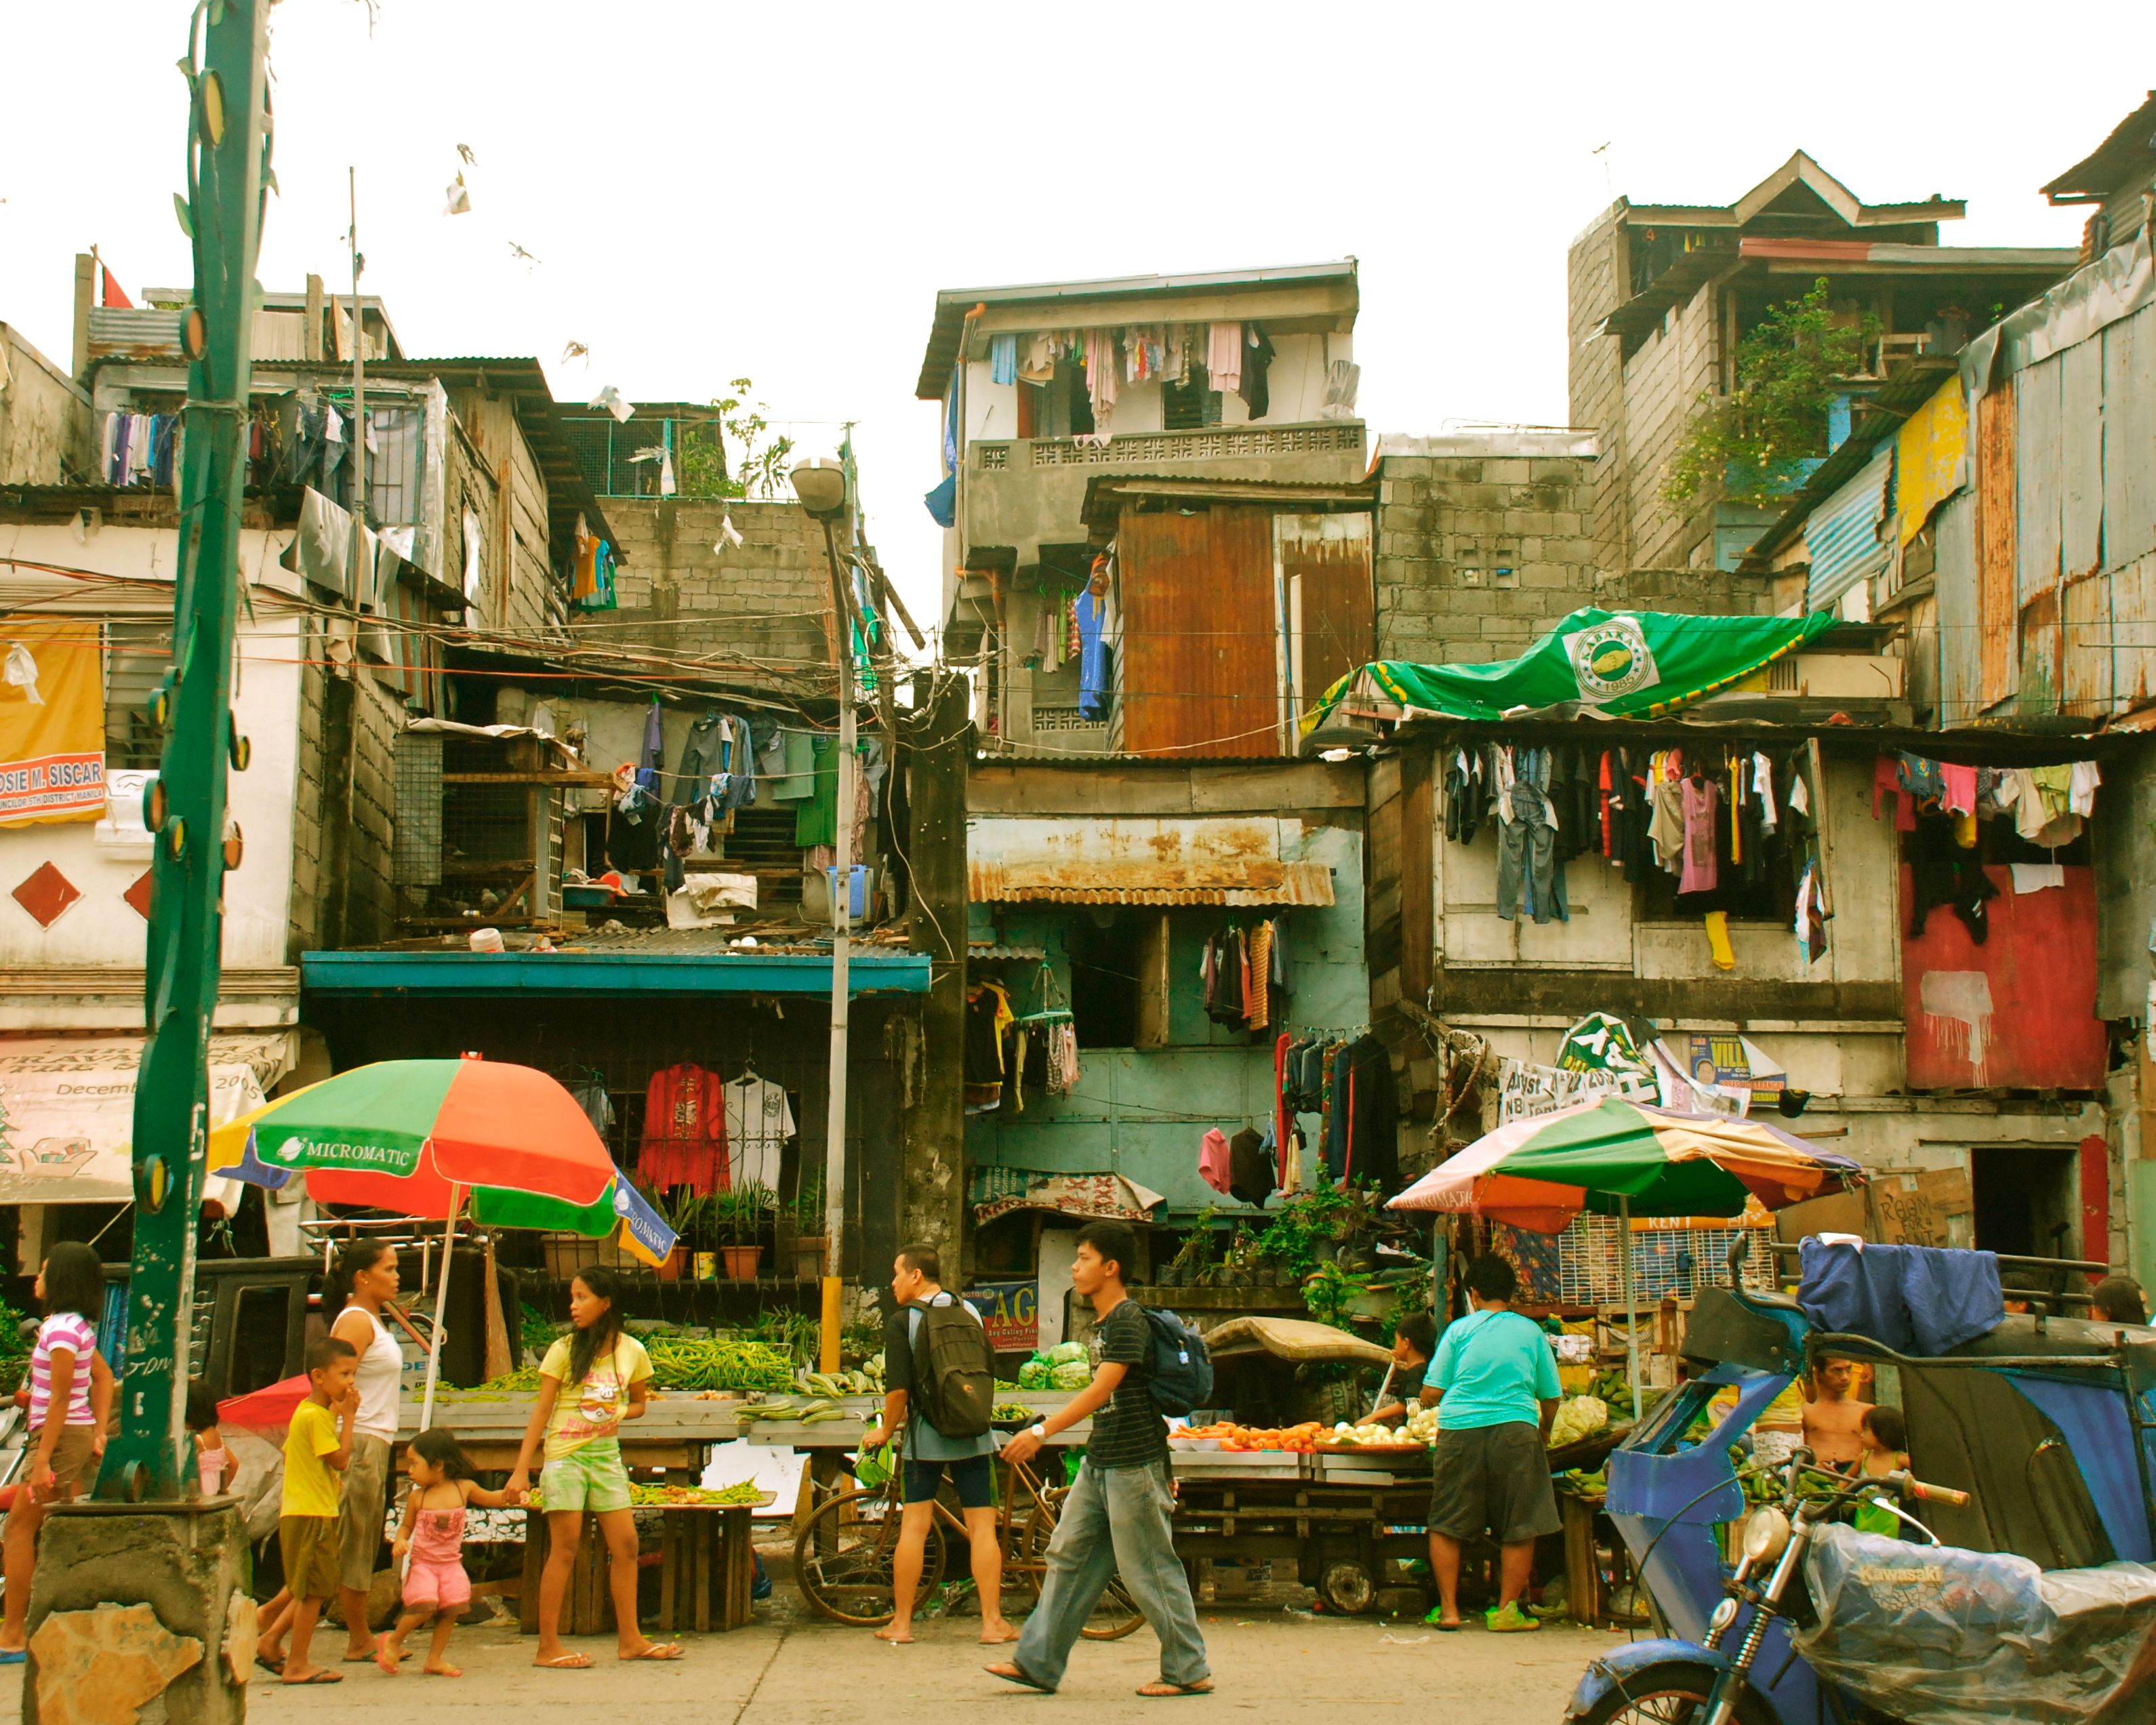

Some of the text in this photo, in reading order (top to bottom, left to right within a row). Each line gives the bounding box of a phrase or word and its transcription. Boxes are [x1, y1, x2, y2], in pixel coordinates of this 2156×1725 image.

[1581, 631, 1633, 660] KABAKA
[1604, 675, 1635, 691] 1985
[31, 767, 46, 790] M.
[49, 762, 102, 786] SISCAR
[43, 791, 75, 805] DISTRICT
[76, 787, 102, 800] MANILA
[215, 1076, 261, 1100] 2005
[307, 1141, 409, 1166] MICROMATIC
[1879, 1196, 1932, 1221] ROOM
[992, 1287, 1036, 1328] AG
[1860, 1566, 1944, 1583] Kawasaki
